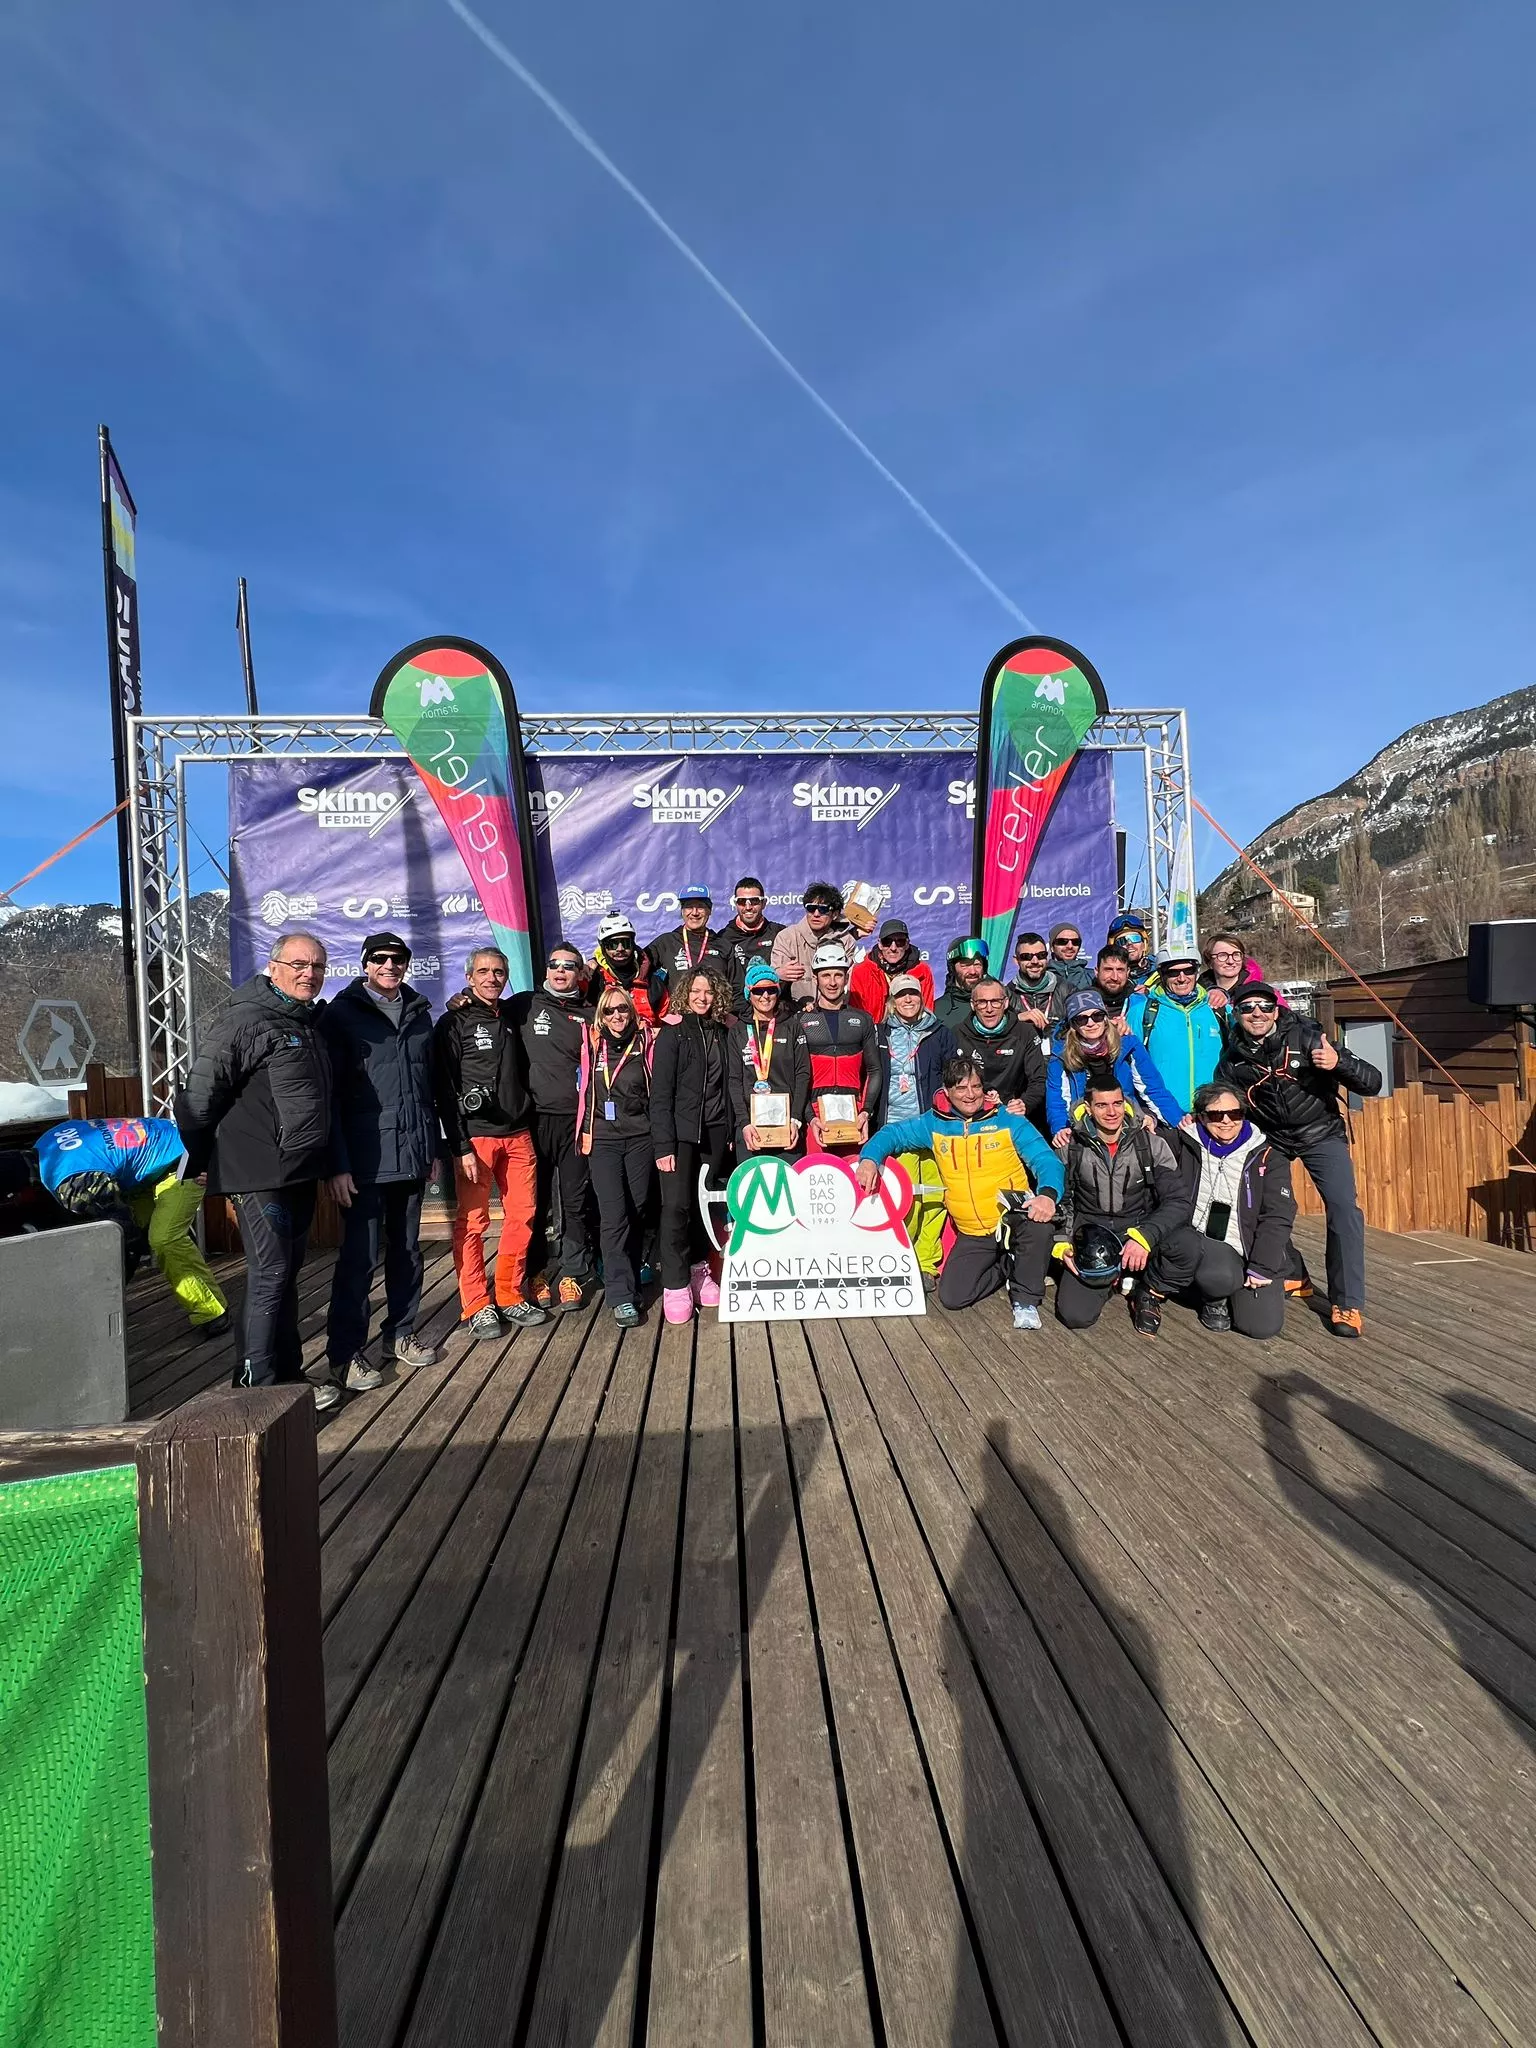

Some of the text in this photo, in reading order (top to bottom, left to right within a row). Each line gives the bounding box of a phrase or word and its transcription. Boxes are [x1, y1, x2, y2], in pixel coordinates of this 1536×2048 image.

[1031, 700, 1064, 717] aramon
[997, 725, 1058, 872] cerler
[325, 815, 371, 824] FEDME
[658, 811, 702, 820] FEDME
[817, 809, 859, 818] FEDME
[1030, 883, 1091, 898] Iberdrola
[323, 964, 360, 977] drola
[984, 1141, 1000, 1150] ESP
[809, 1173, 834, 1186] BAR
[809, 1187, 836, 1201] BAS
[809, 1202, 836, 1215] TRO
[729, 1252, 912, 1278] MONTAÑEROS
[729, 1276, 912, 1291] DE ARAGON
[729, 1287, 914, 1312] BARBASTRO
